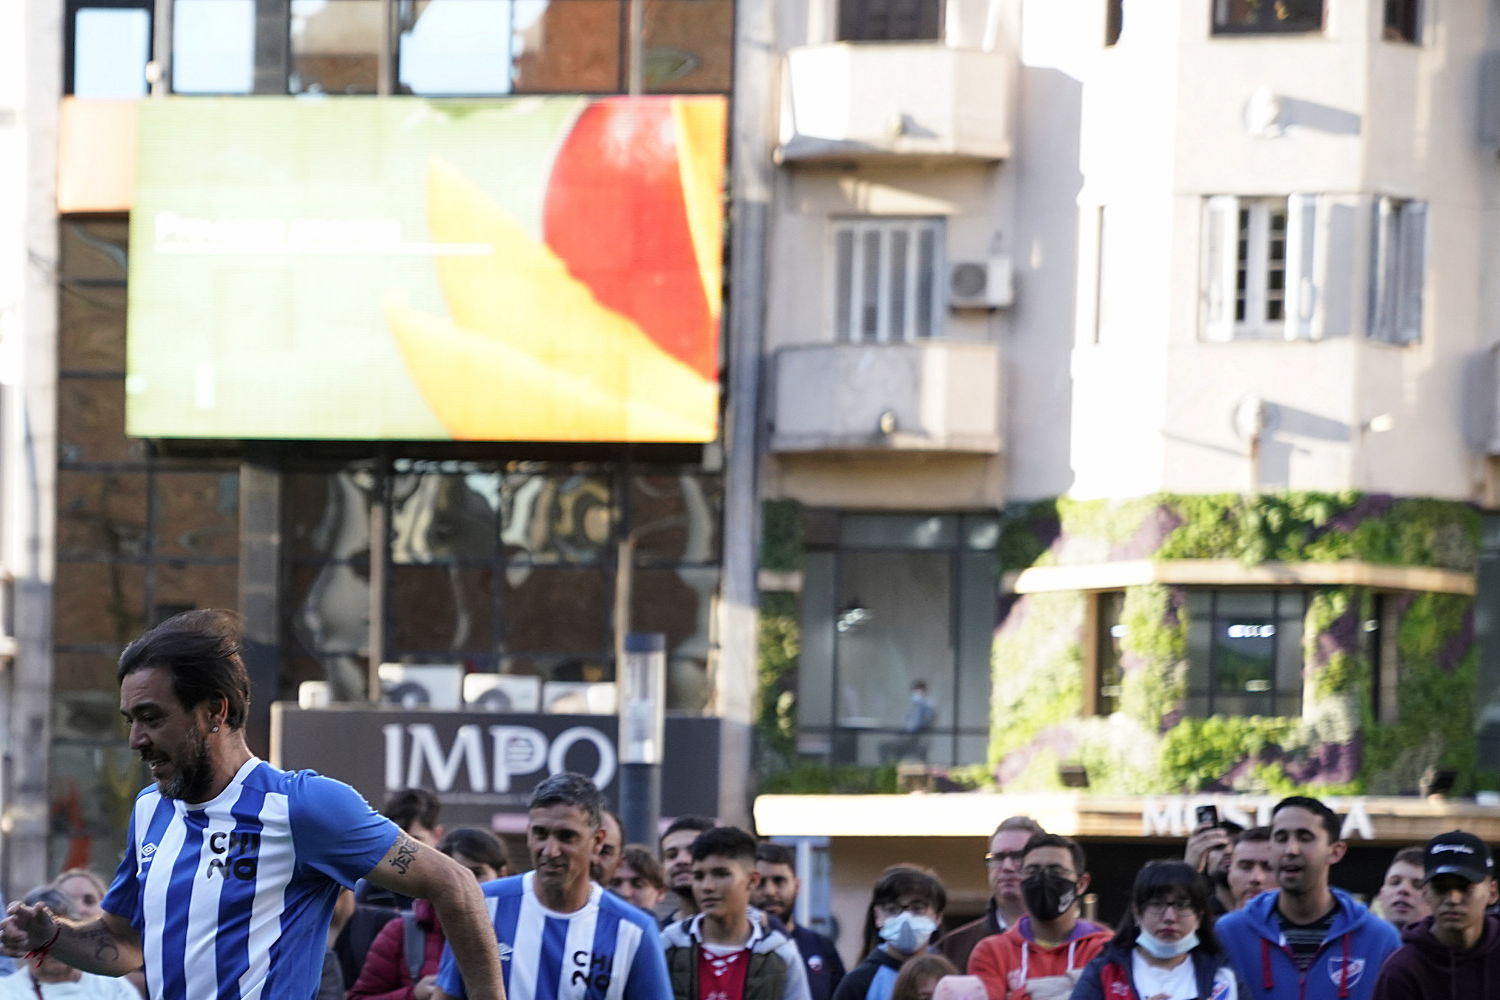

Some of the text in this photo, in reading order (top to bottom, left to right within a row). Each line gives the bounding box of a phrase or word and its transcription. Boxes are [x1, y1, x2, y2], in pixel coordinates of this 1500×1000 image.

[382, 723, 617, 792] IMPO
[210, 832, 260, 855] CHI
[573, 950, 613, 971] CHI
